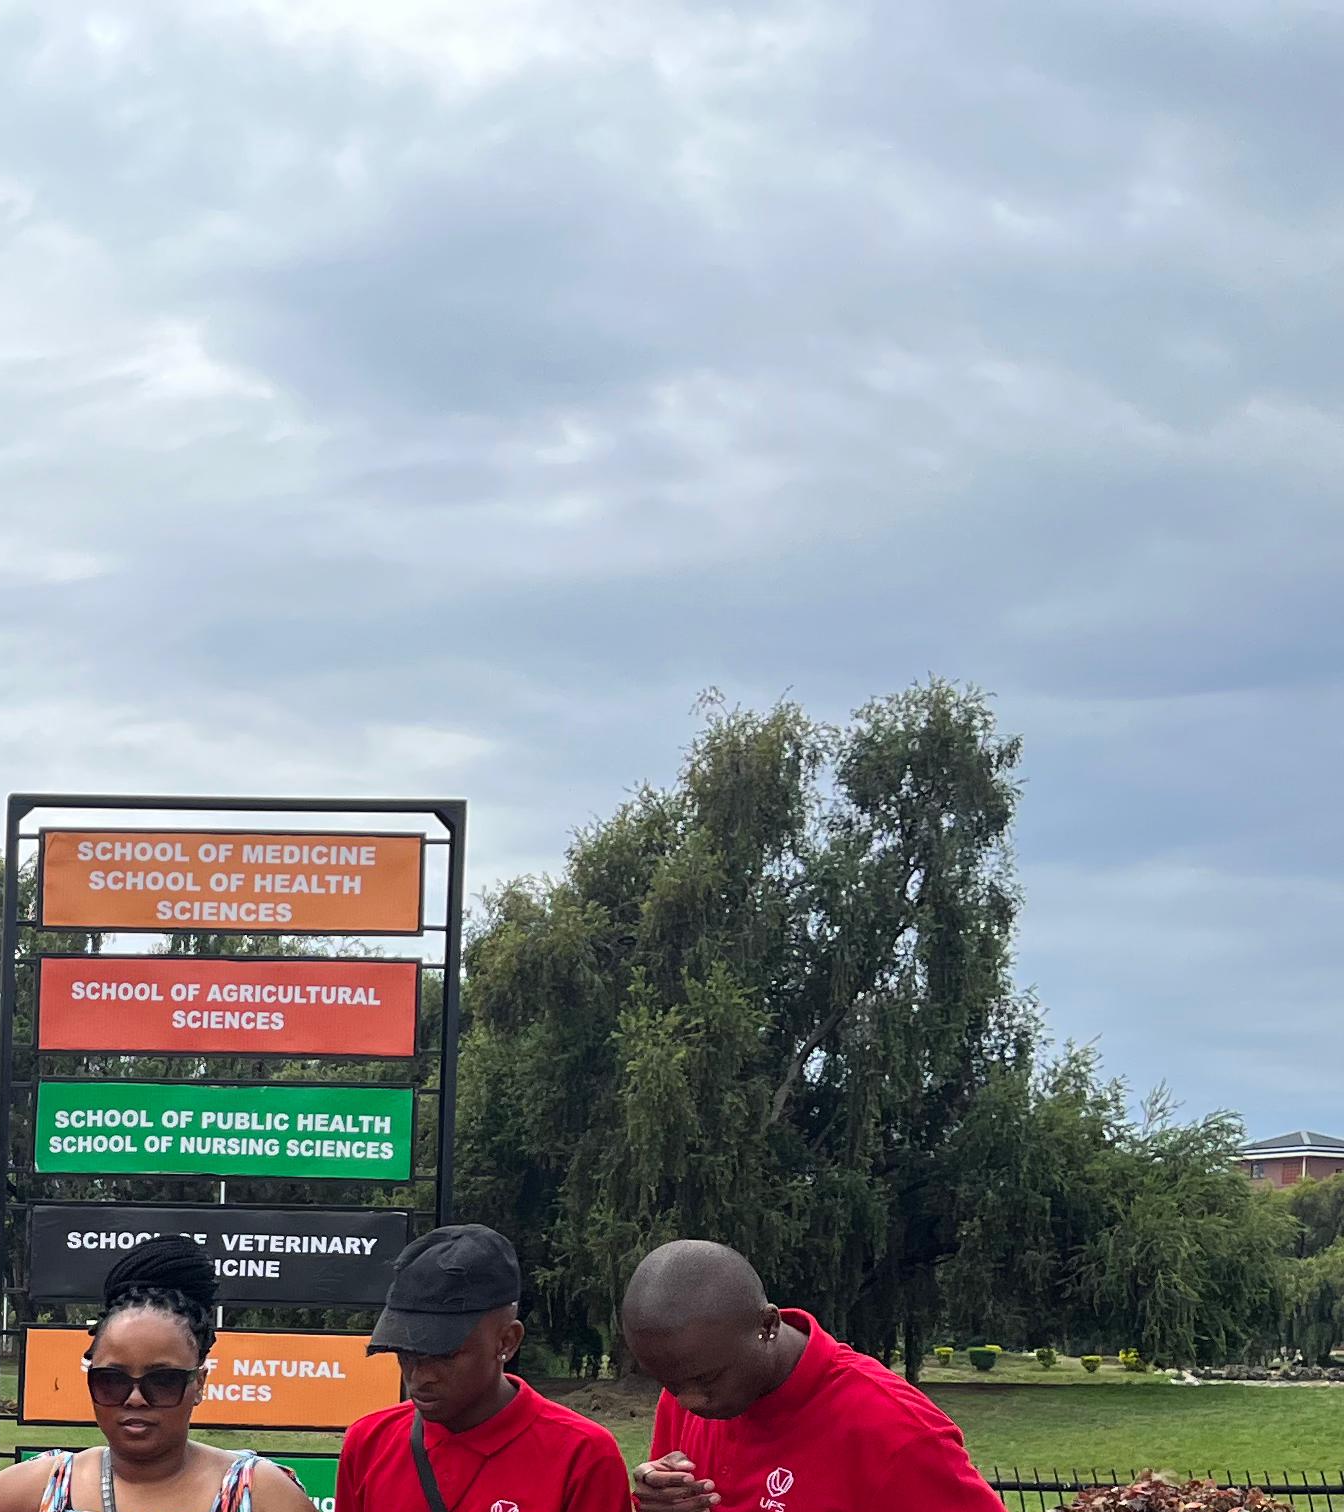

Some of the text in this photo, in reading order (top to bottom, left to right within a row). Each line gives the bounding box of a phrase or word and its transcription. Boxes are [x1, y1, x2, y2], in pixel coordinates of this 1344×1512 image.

[77, 842, 376, 866] SCHOOL OF MEDICINE
[88, 871, 362, 895] SCHOOL OF HEALTH
[156, 900, 292, 922] SCIENCES
[71, 981, 381, 1006] SCHOOL OF AGRICULTURAL
[171, 1010, 285, 1031] SCIENCES
[54, 1108, 391, 1134] SCHOOL OF PUBLIC HEALTH
[48, 1135, 394, 1160] SCHOOL OF NURSING SCIENCES
[66, 1231, 160, 1249] SCHOO
[221, 1233, 378, 1256] VETERINARY
[214, 1258, 280, 1278] ICINE
[233, 1359, 346, 1380] NATURAL
